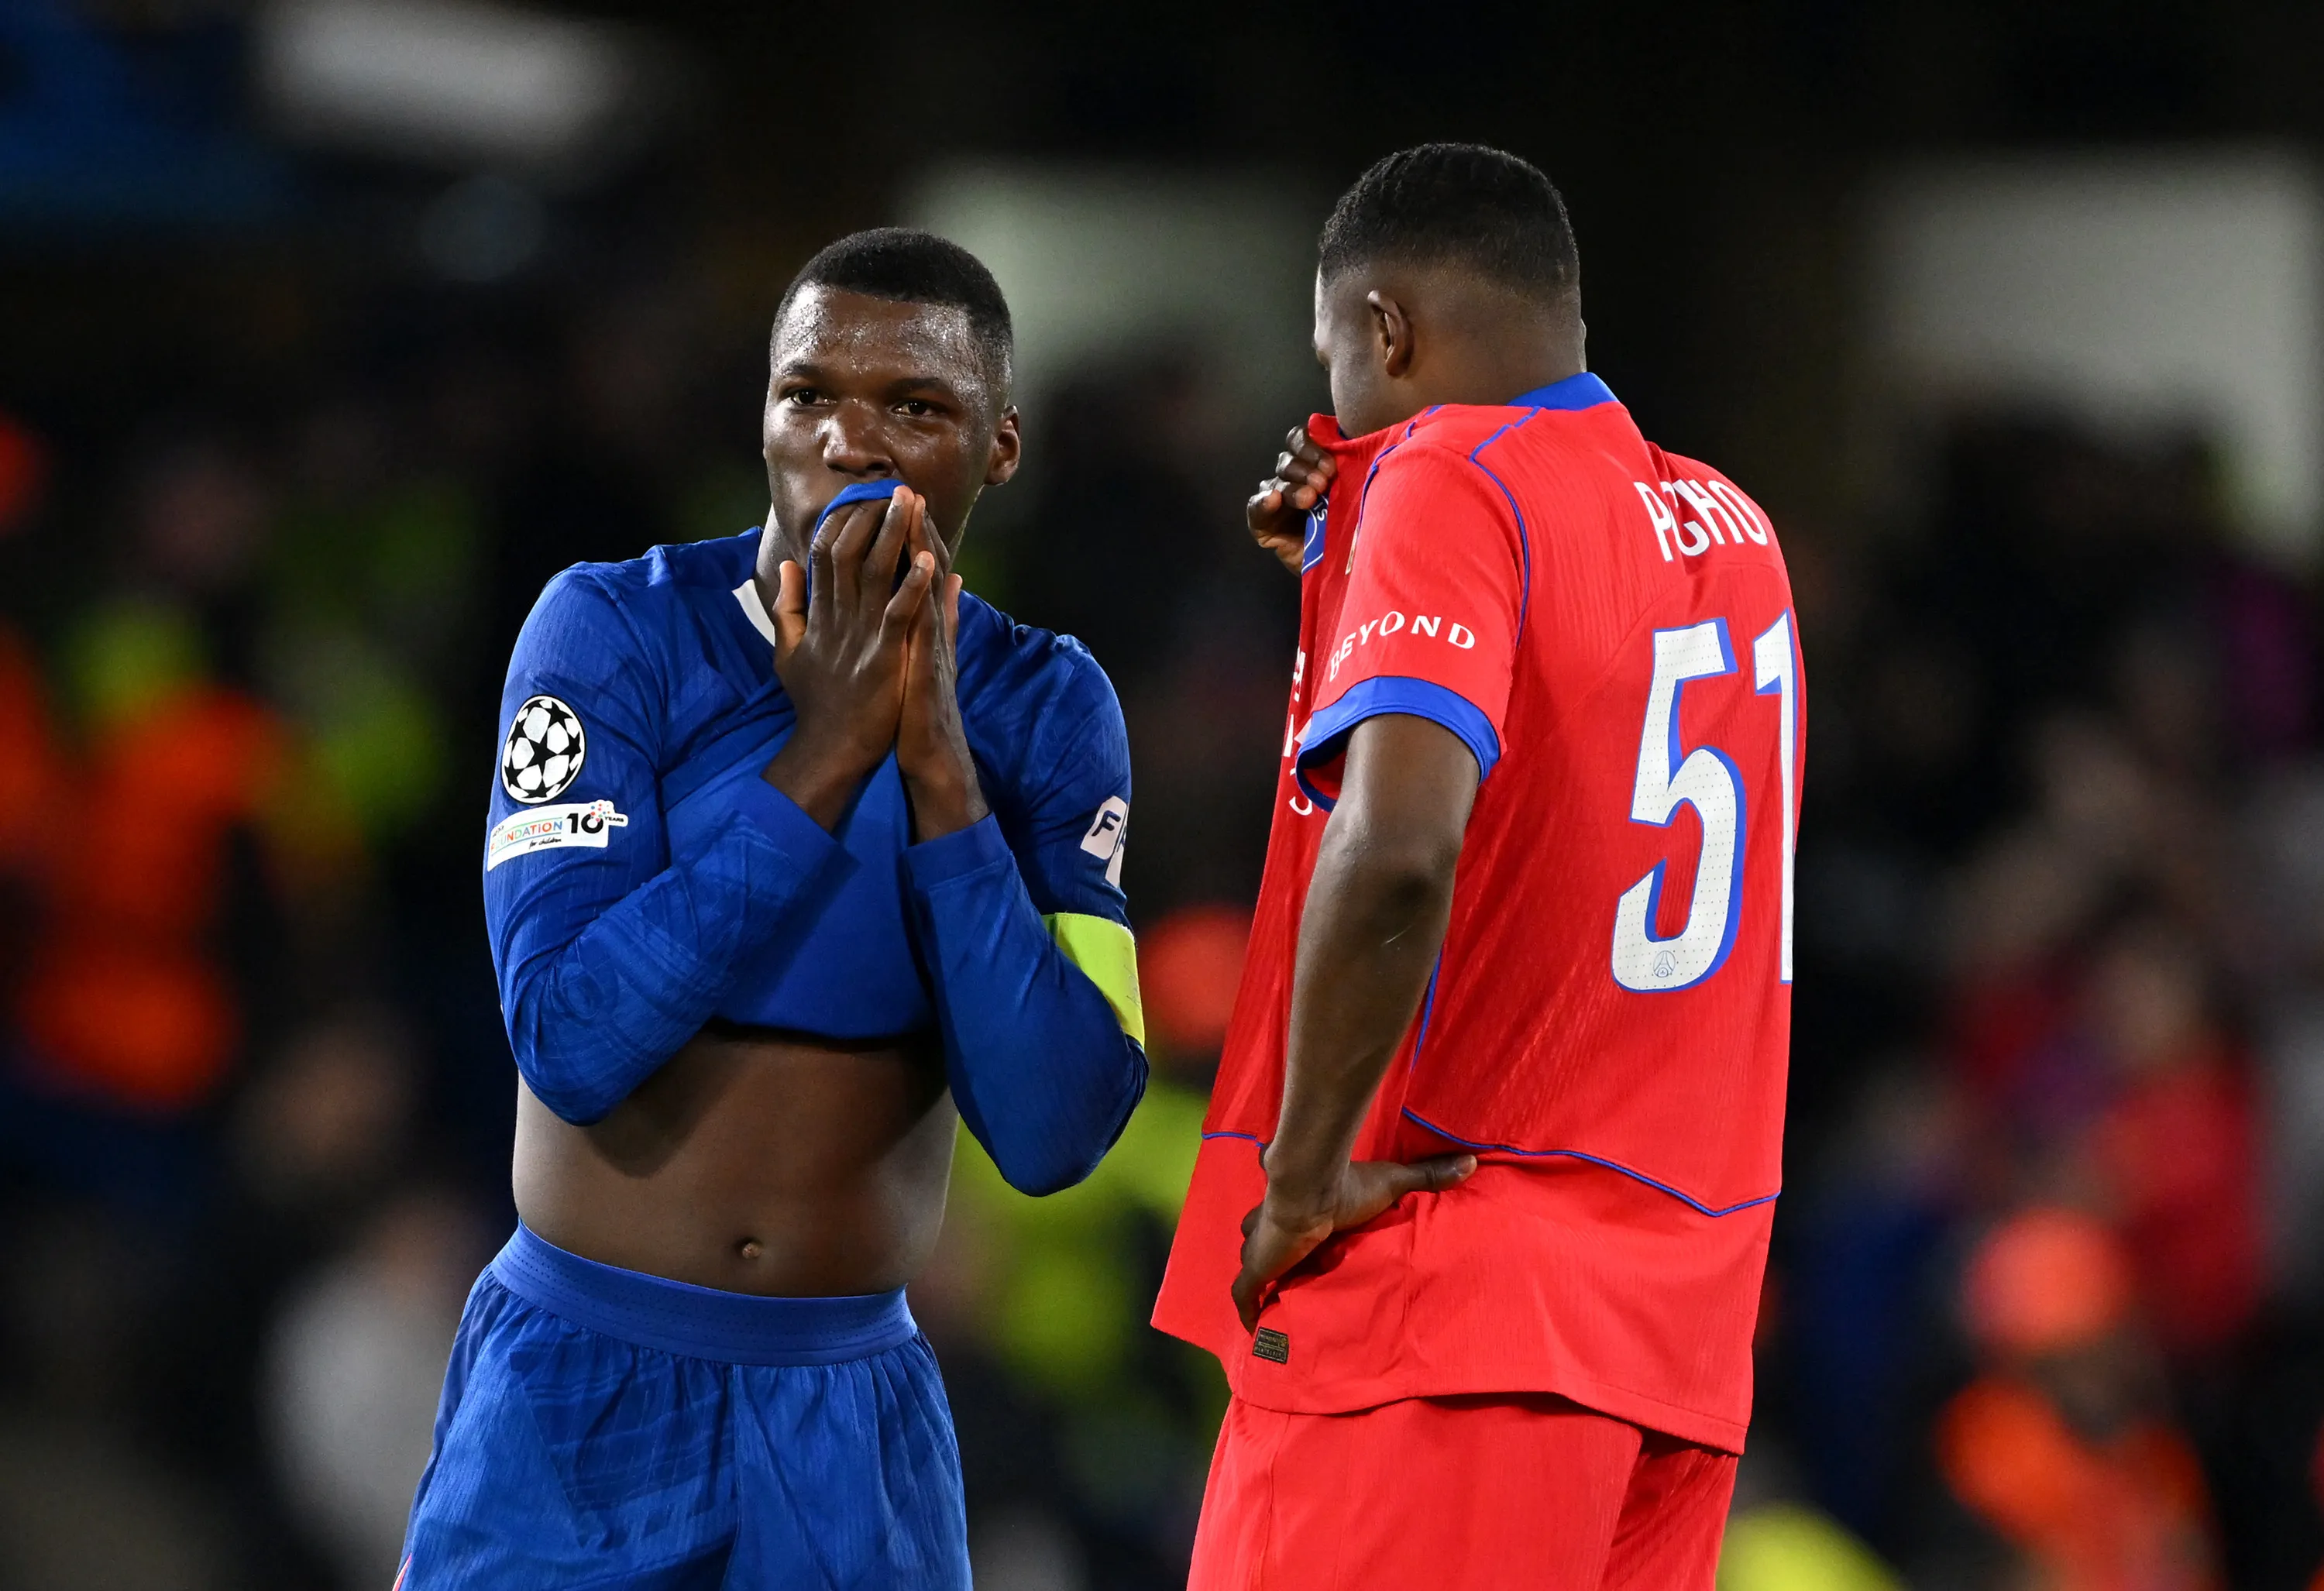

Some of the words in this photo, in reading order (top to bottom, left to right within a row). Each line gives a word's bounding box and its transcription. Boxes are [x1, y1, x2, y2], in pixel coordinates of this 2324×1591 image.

[1633, 479, 1769, 562] PCHO
[1329, 610, 1476, 682] BEYOND
[566, 813, 604, 834] 10
[1611, 607, 1795, 993] 51
